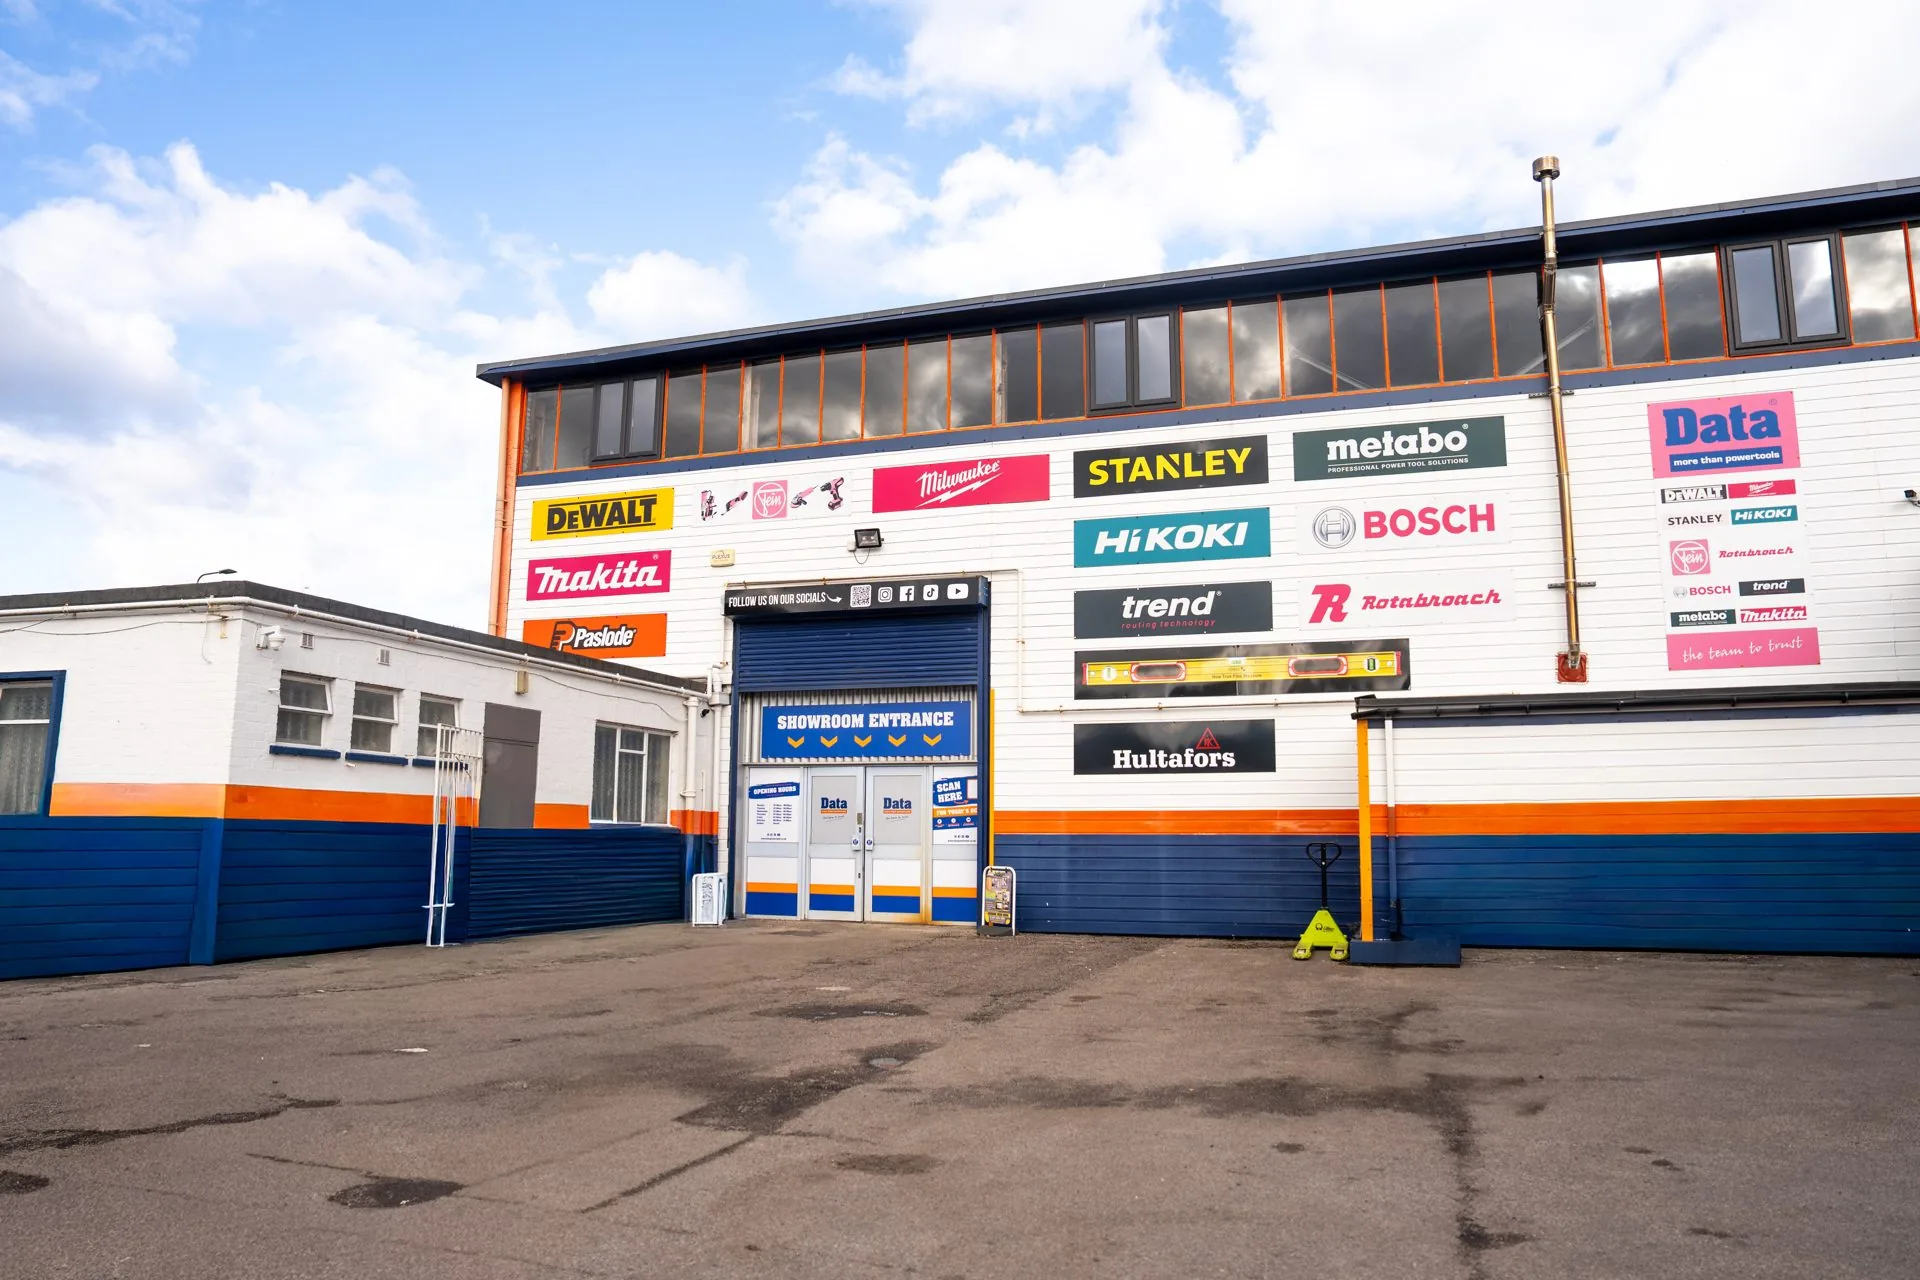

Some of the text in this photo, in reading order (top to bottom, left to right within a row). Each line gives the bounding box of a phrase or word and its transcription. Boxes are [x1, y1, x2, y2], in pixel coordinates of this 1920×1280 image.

[1662, 404, 1781, 447] Data
[1327, 426, 1468, 461] metabo
[1328, 464, 1380, 473] PROFESSIONAL
[1428, 457, 1469, 466] SOLUTIONS
[1673, 451, 1780, 466] more than powertools
[1088, 447, 1252, 487] STANLEY
[915, 459, 1001, 498] Milwaukee
[1363, 503, 1496, 539] BOSCH
[1667, 514, 1722, 526] STANLEY
[1734, 508, 1792, 521] HiKOKI
[1093, 521, 1249, 555] HiKOKI
[1718, 546, 1794, 558] Rotabroach
[1689, 585, 1731, 596] BOSCH
[1753, 580, 1788, 591] trend
[728, 591, 826, 607] FOLLOW US ON OUR SOCIALS
[1122, 590, 1216, 618] trend
[1309, 584, 1352, 623] R
[1361, 589, 1502, 610] Rotabroach
[1159, 619, 1216, 628] technology
[1678, 611, 1727, 622] metabo
[574, 626, 634, 648] Paslode
[1682, 635, 1803, 663] the team to trust
[777, 711, 954, 730] SHOWROOM ENTRANCE
[1113, 749, 1236, 769] Hultafors
[937, 781, 961, 792] SCAN
[821, 797, 848, 809] Data
[883, 797, 912, 809] Data
[938, 791, 963, 803] HERE
